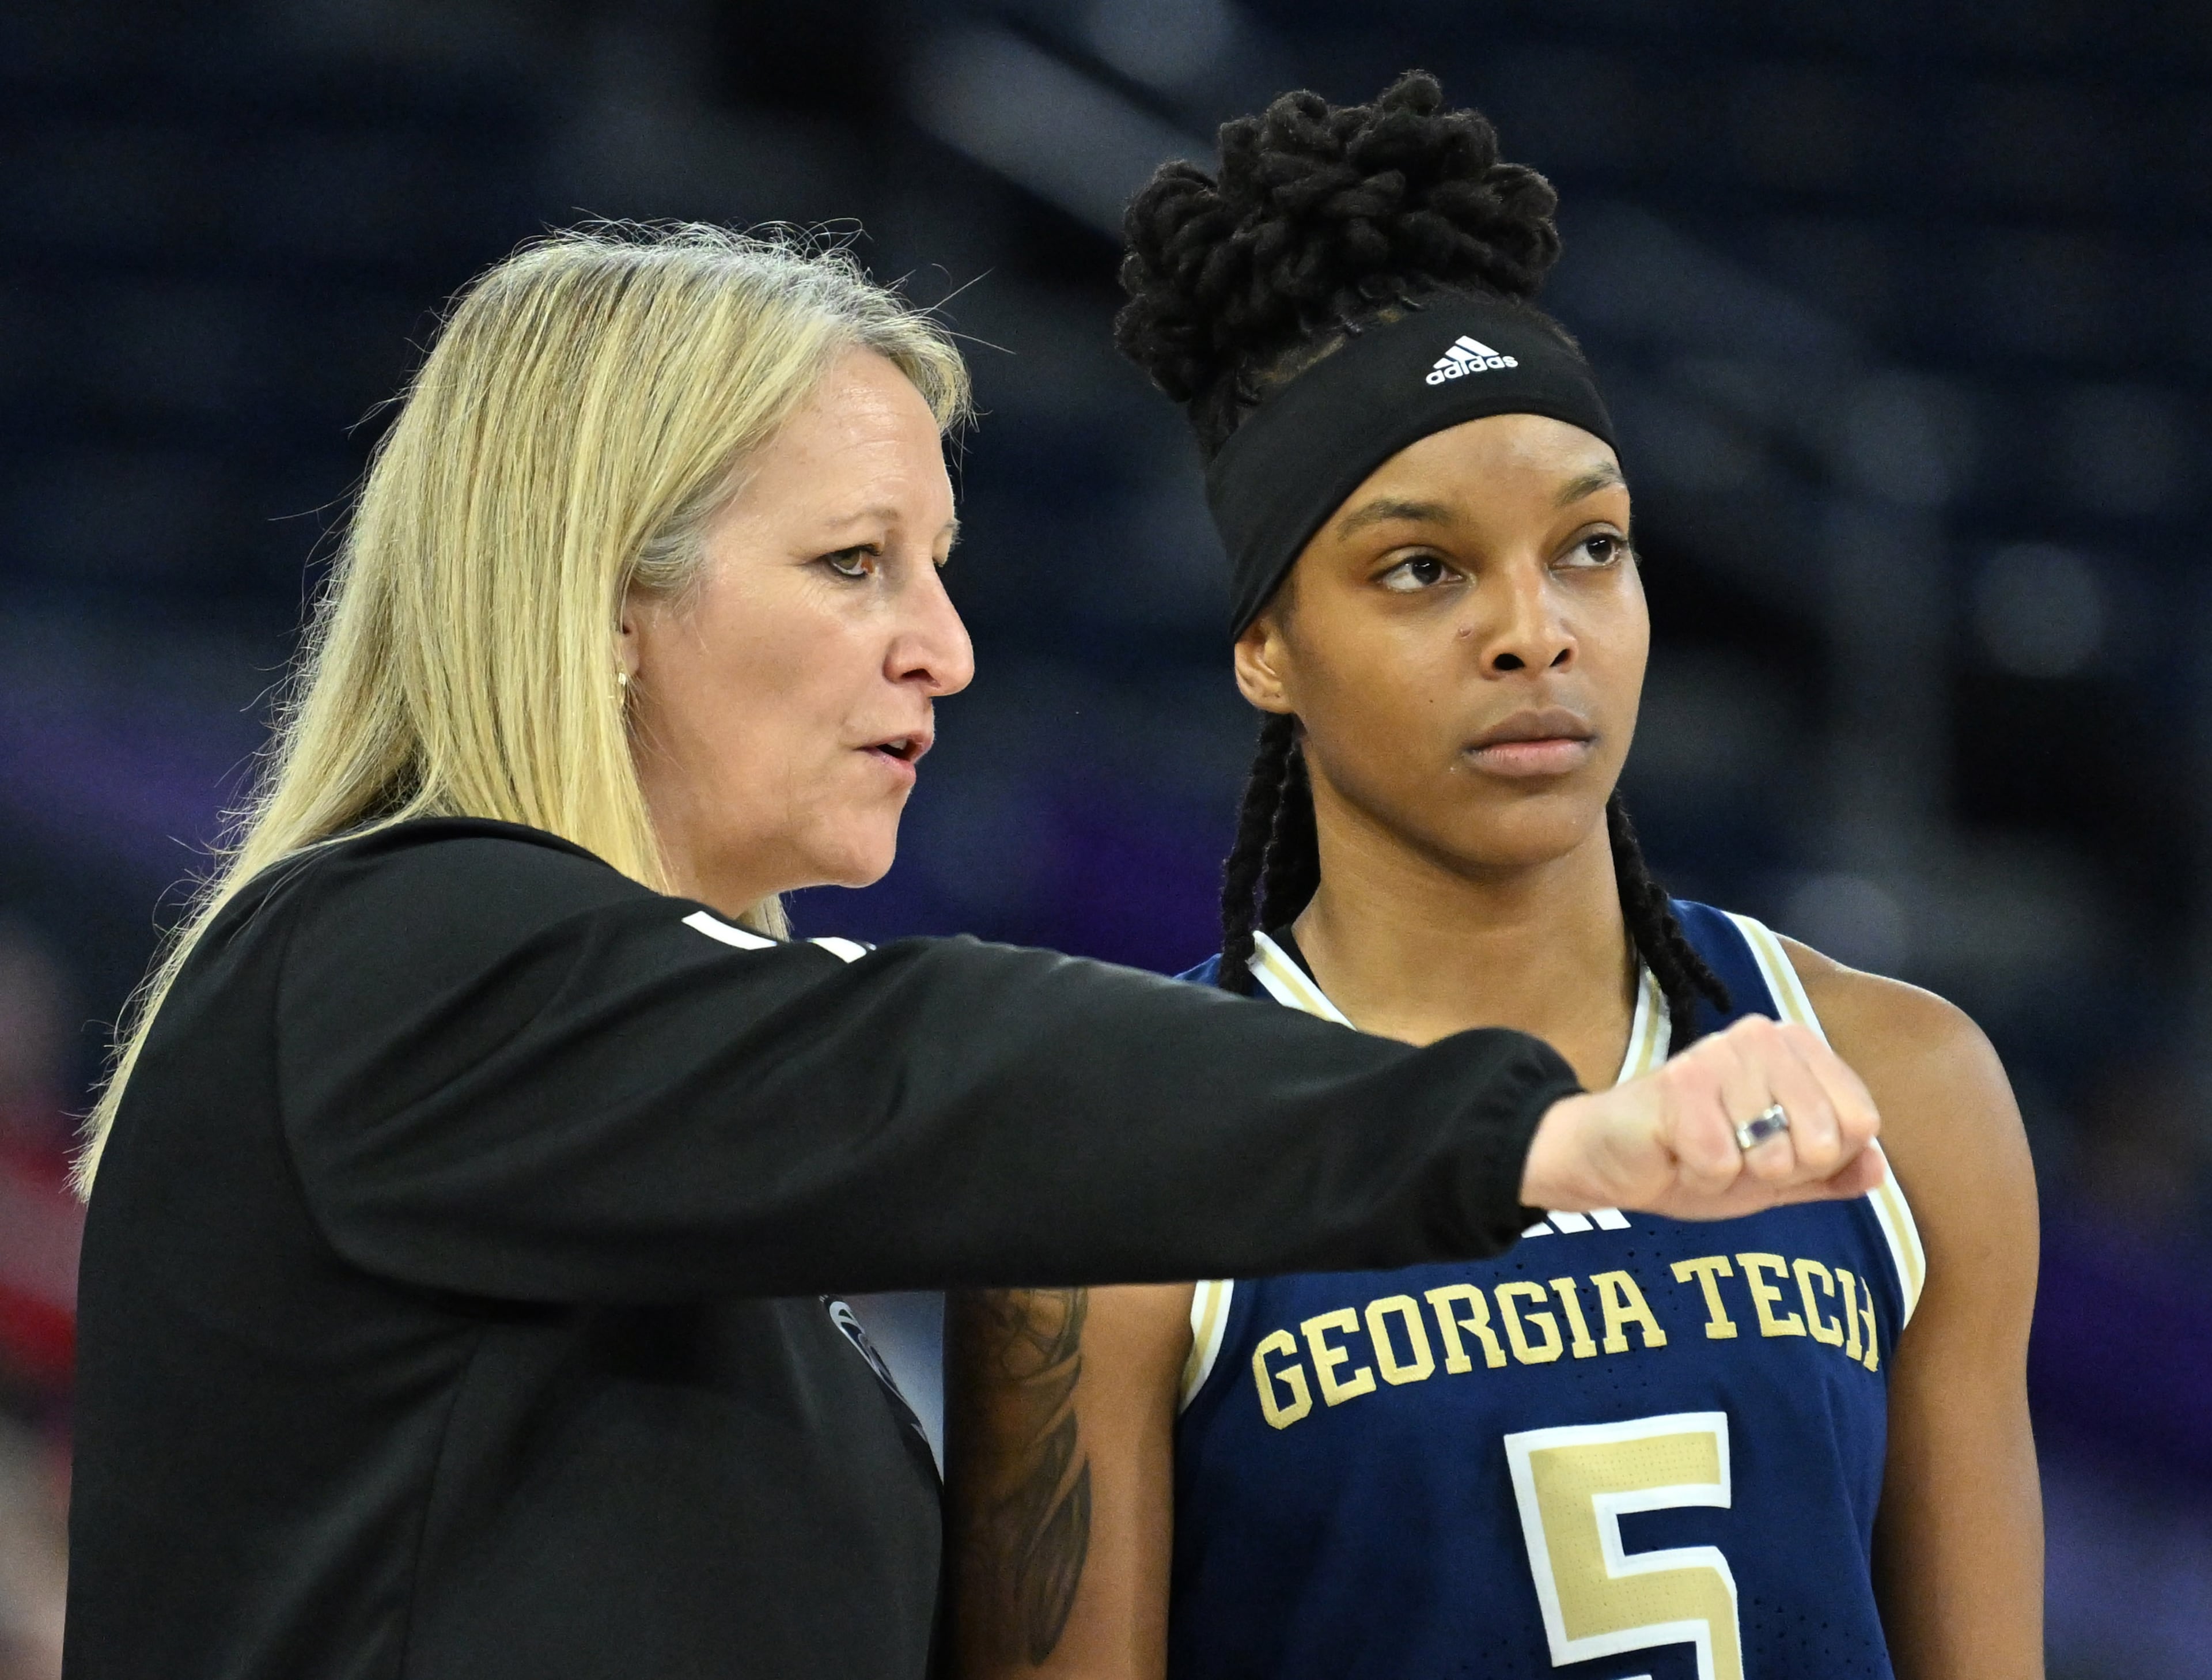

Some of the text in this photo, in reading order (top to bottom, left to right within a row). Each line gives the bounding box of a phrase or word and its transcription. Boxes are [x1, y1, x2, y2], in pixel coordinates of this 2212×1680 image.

[1426, 355, 1518, 385] adidas
[1252, 1253, 1879, 1429] GEORGIA TECH
[1503, 1412, 1744, 1680] 5
